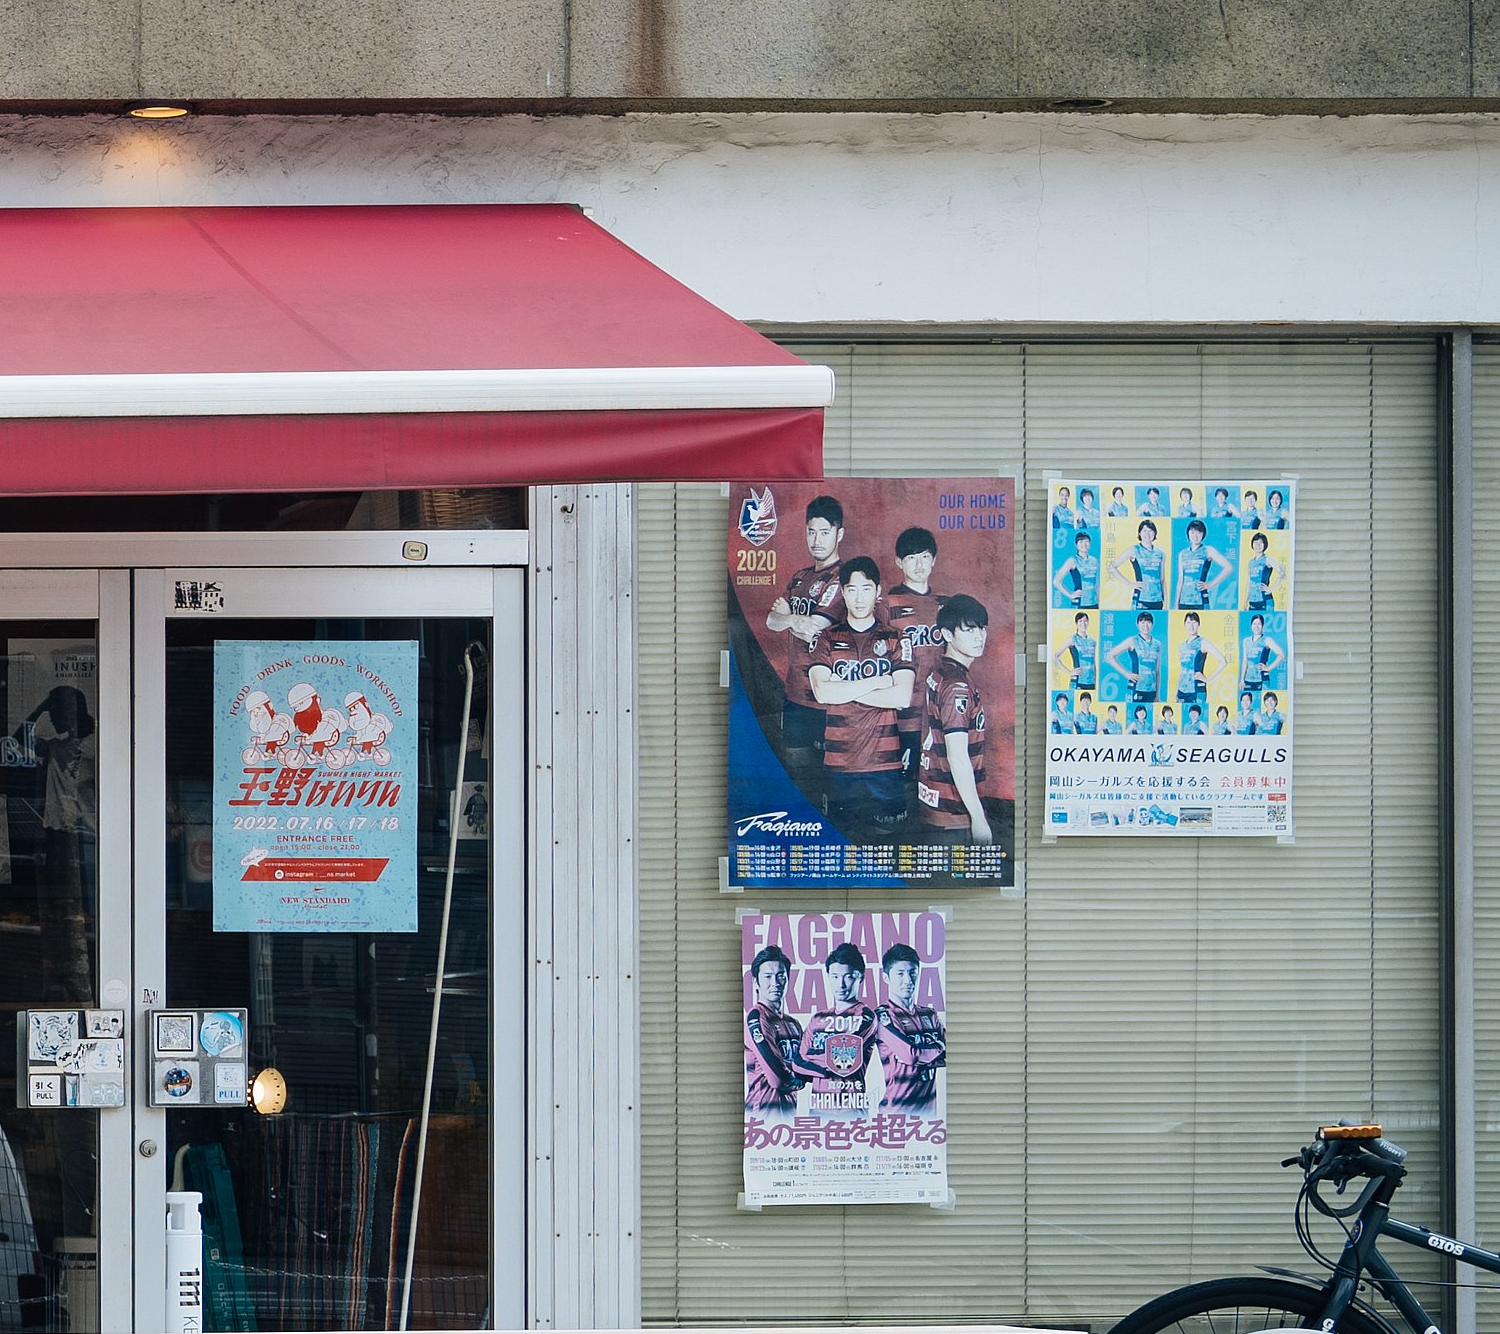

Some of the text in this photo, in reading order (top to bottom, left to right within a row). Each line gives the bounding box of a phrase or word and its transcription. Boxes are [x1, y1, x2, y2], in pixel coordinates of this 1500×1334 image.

[939, 493, 1006, 509] OUR HOME
[939, 515, 1006, 530] OUR CLUB
[736, 550, 777, 571] 2020
[303, 654, 346, 667] GOODS
[256, 658, 293, 681] DRINK
[355, 664, 403, 717] WORKSHOP
[229, 684, 251, 716] FOOD
[1050, 747, 1287, 763] OKAYAMA SEAGULLS
[228, 768, 402, 807] 玉野けいりん
[1049, 775, 1287, 788] 岡山シーガルズを応援する会 会員募集中
[232, 816, 334, 831] 2022.07.16
[380, 816, 399, 831] 18
[276, 835, 354, 843] ENTRANCE FREE
[270, 844, 289, 852] open
[285, 871, 314, 880] instagram
[302, 896, 350, 904] STANDARD
[824, 1016, 863, 1033] 2017
[35, 1080, 54, 1090] 引く
[827, 1080, 863, 1090] 真の力を
[219, 1090, 242, 1099] PULL
[744, 1113, 947, 1151] あの景色を超える
[1428, 1234, 1465, 1257] GIOS
